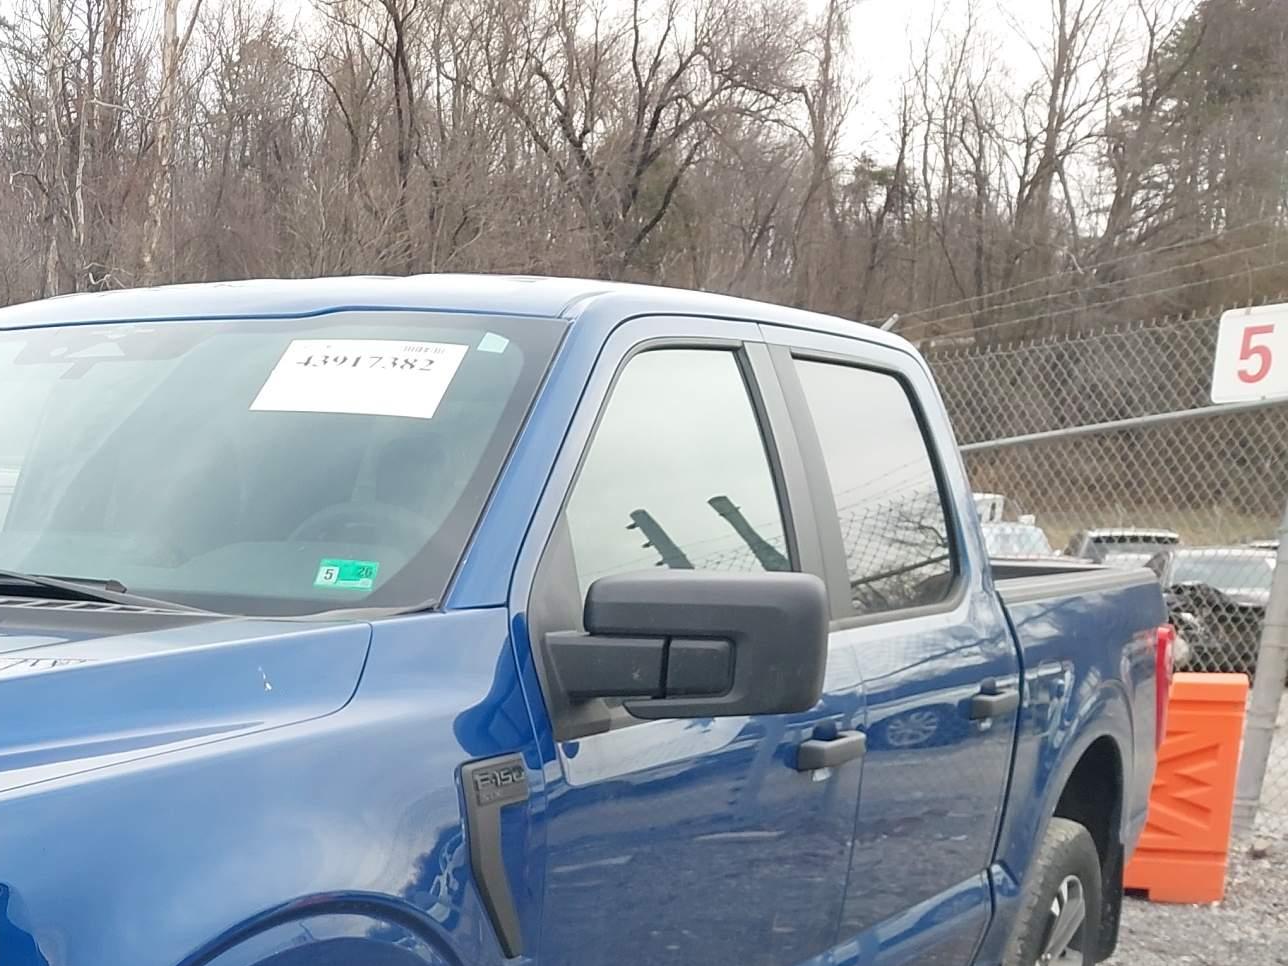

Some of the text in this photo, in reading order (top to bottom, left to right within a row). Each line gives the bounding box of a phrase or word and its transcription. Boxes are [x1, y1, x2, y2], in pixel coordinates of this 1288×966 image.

[1237, 323, 1275, 384] 5
[296, 354, 436, 372] 43917382
[323, 568, 334, 581] 5
